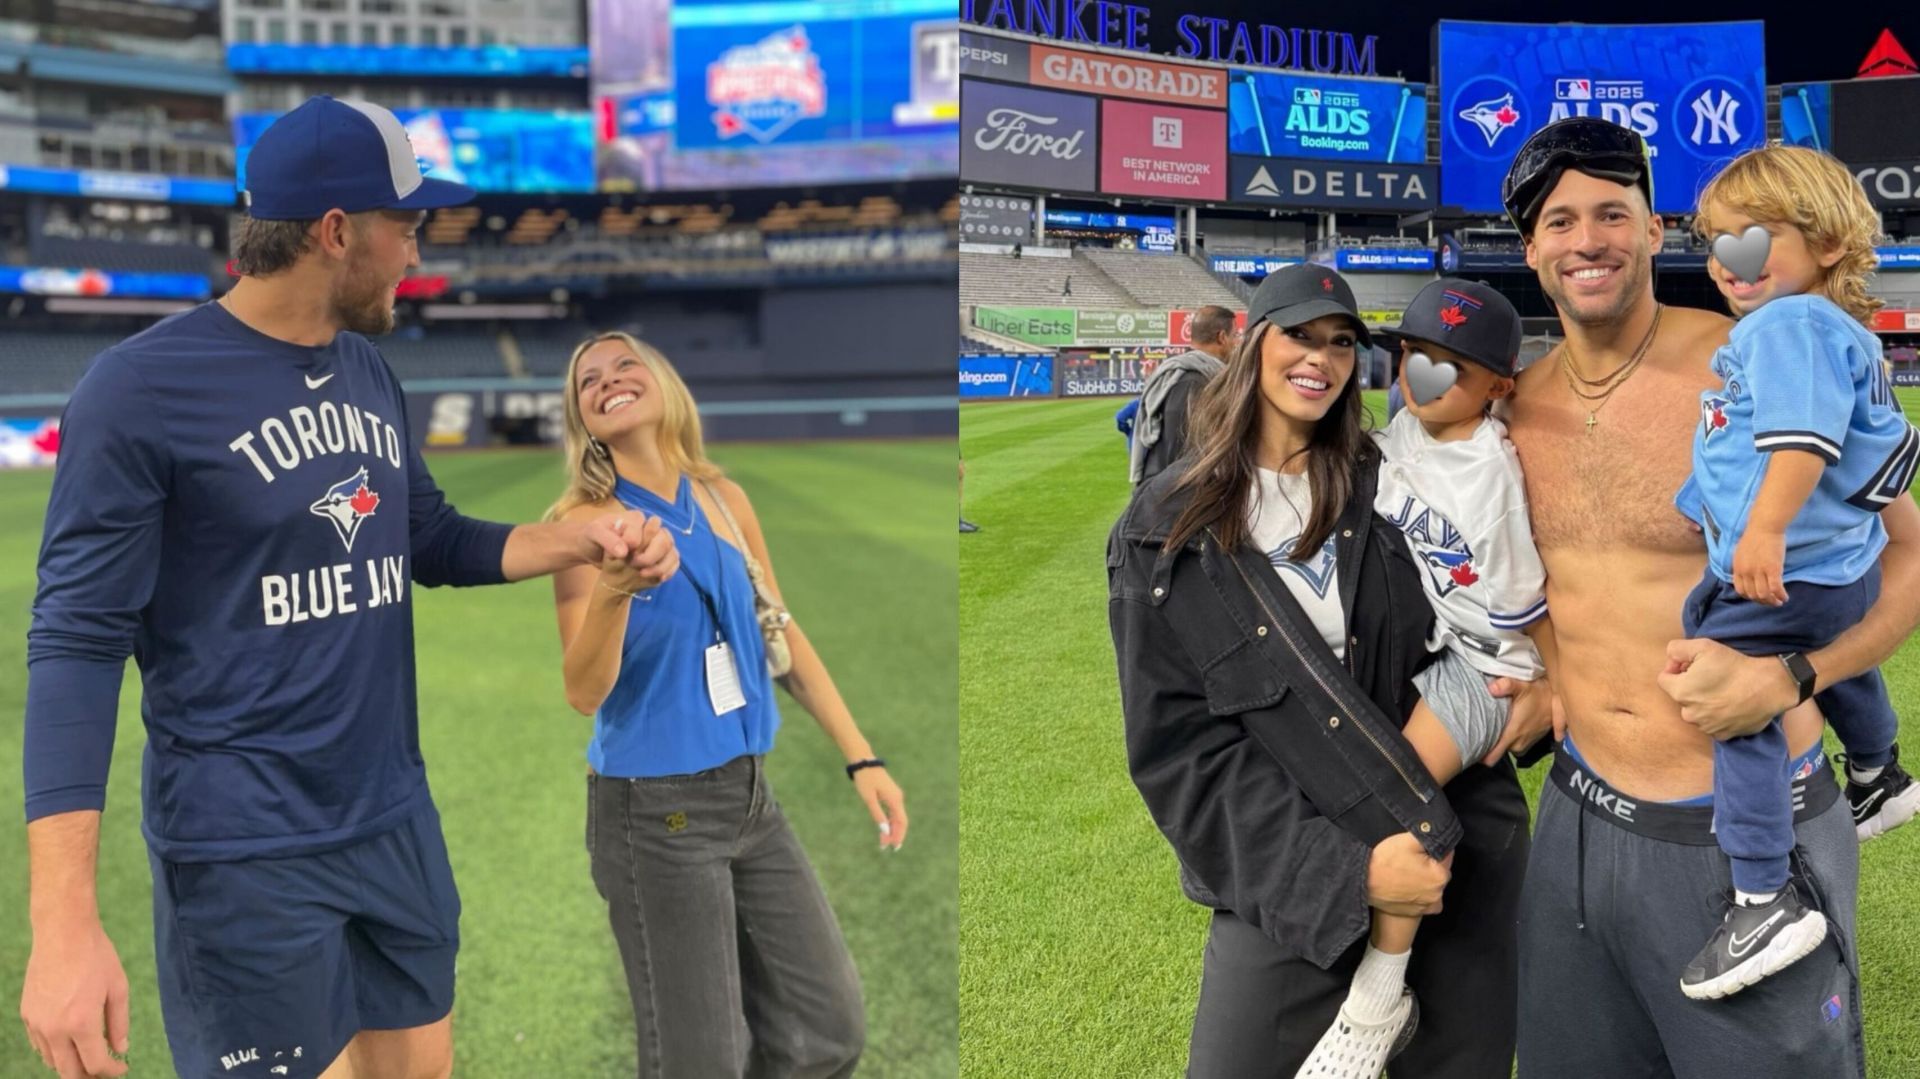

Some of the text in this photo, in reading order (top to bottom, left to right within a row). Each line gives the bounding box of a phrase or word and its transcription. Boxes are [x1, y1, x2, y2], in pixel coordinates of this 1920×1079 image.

[960, 46, 1008, 65] PEPSI
[1176, 14, 1378, 76] STADIUM
[1043, 55, 1217, 99] GATORADE
[1323, 96, 1359, 107] 2025
[1594, 87, 1643, 99] 2025
[1285, 104, 1369, 135] ALDS
[974, 108, 1084, 160] Ford
[1301, 135, 1369, 151] Booking.com
[1122, 157, 1210, 174] BEST NETWORK
[1133, 170, 1200, 185] IN AMERICA
[1293, 170, 1427, 200] DELTA
[979, 317, 1072, 336] Uber Eats
[1067, 380, 1117, 395] StubHub
[228, 401, 401, 483] TORONTO
[261, 563, 357, 626] BLUE
[1569, 770, 1636, 823] NIKE
